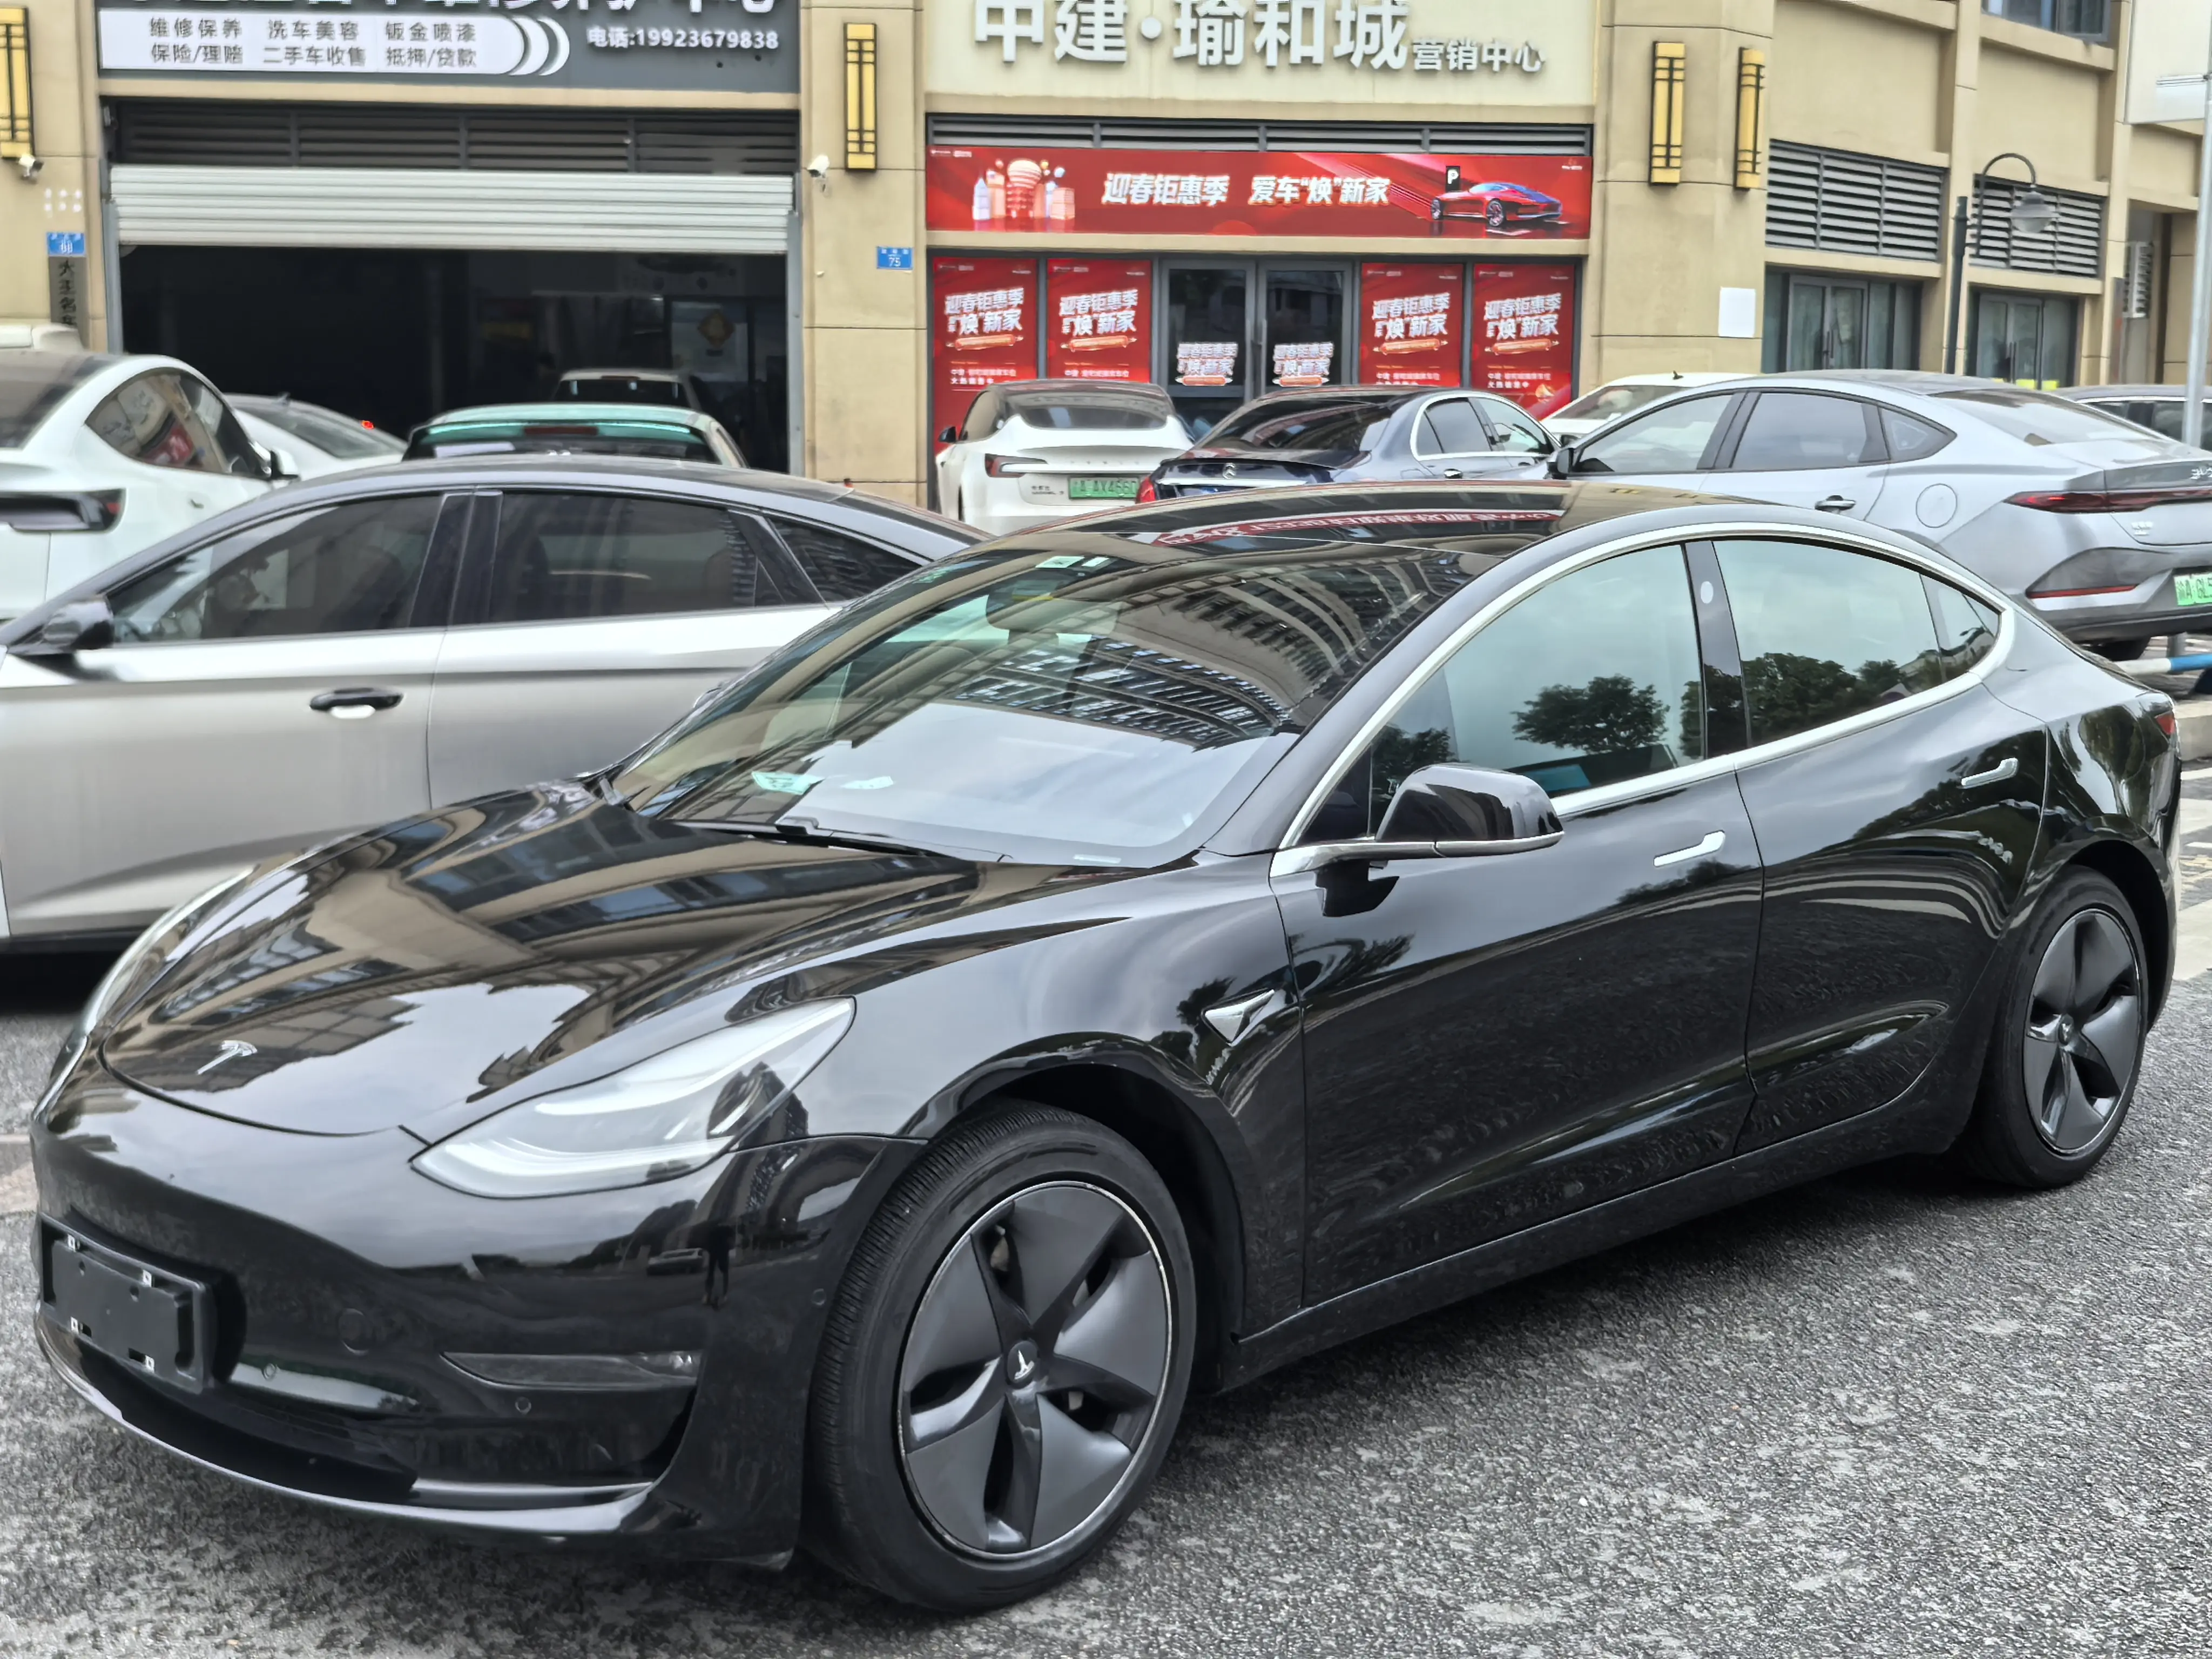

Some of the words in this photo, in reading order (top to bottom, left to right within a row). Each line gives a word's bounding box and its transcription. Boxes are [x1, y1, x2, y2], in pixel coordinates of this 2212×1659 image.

[150, 18, 242, 38] 维修保养
[268, 19, 360, 41] 洗车美容
[386, 21, 476, 42] 钣金喷漆
[151, 43, 243, 65] 保险/理赔
[263, 46, 367, 67] 二手车收售
[386, 46, 477, 68] 抵押/贷款
[1412, 39, 1545, 72] 营销中心
[1447, 169, 1459, 185] P
[1102, 173, 1230, 207] 迎春钜惠季
